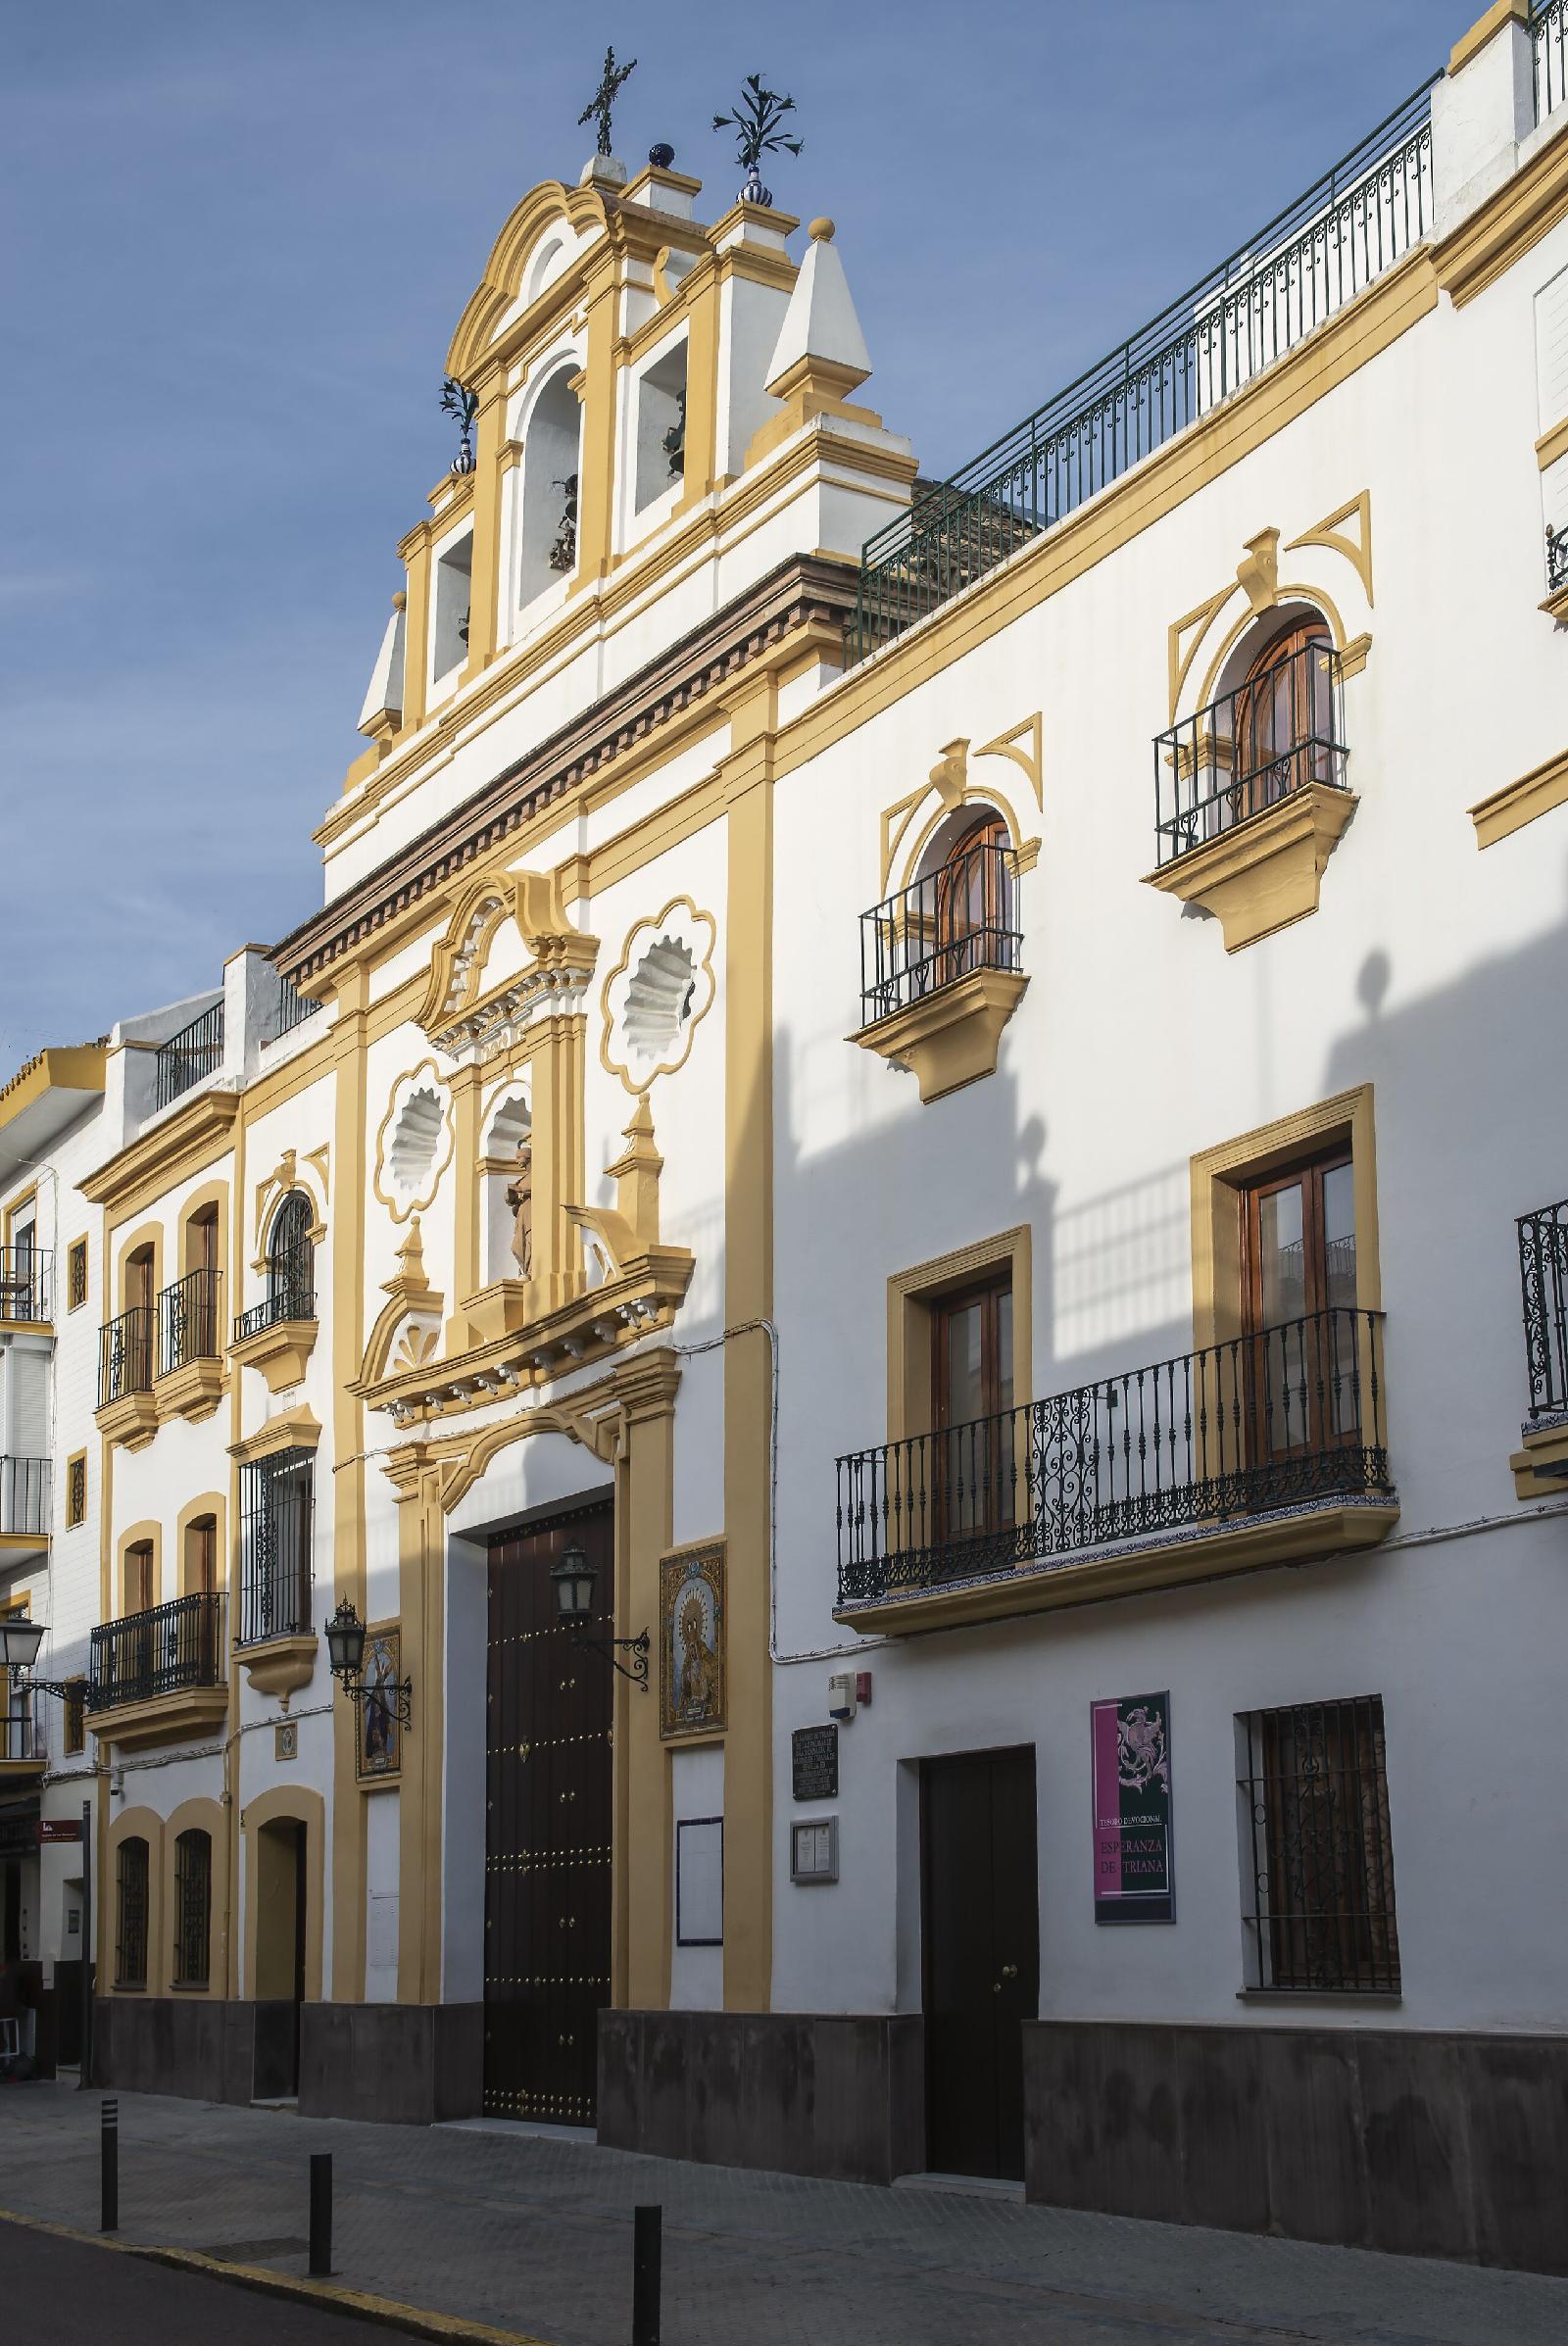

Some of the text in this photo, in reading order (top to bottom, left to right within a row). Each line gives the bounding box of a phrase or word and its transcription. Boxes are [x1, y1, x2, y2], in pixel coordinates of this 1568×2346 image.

[1124, 1815, 1161, 1825] DEVOCIONAL
[1101, 1839, 1162, 1853] ESPERANZA
[1101, 1860, 1164, 1874] DE TRIANA
